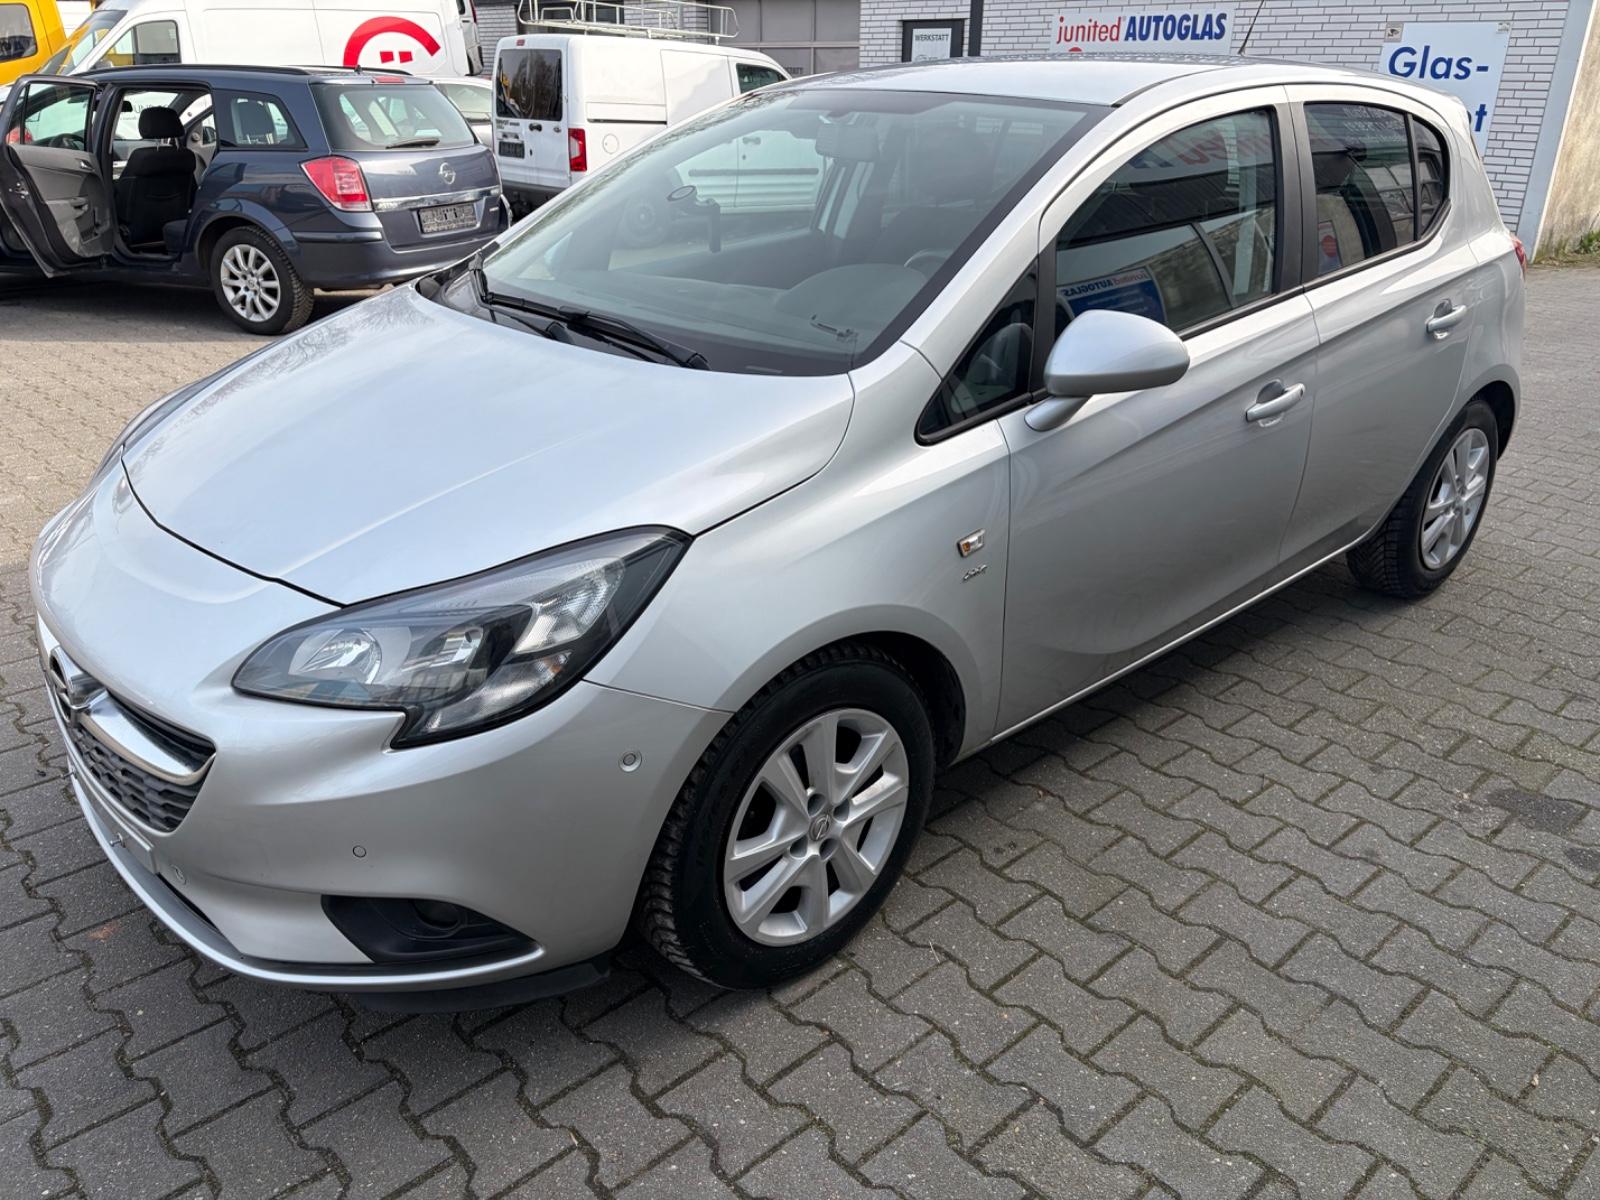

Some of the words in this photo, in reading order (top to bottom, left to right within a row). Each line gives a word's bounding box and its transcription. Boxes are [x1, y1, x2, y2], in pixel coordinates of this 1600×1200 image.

[1056, 16, 1121, 44] junited
[1124, 13, 1227, 42] AUTOGLAS
[1388, 45, 1489, 80] Glas-
